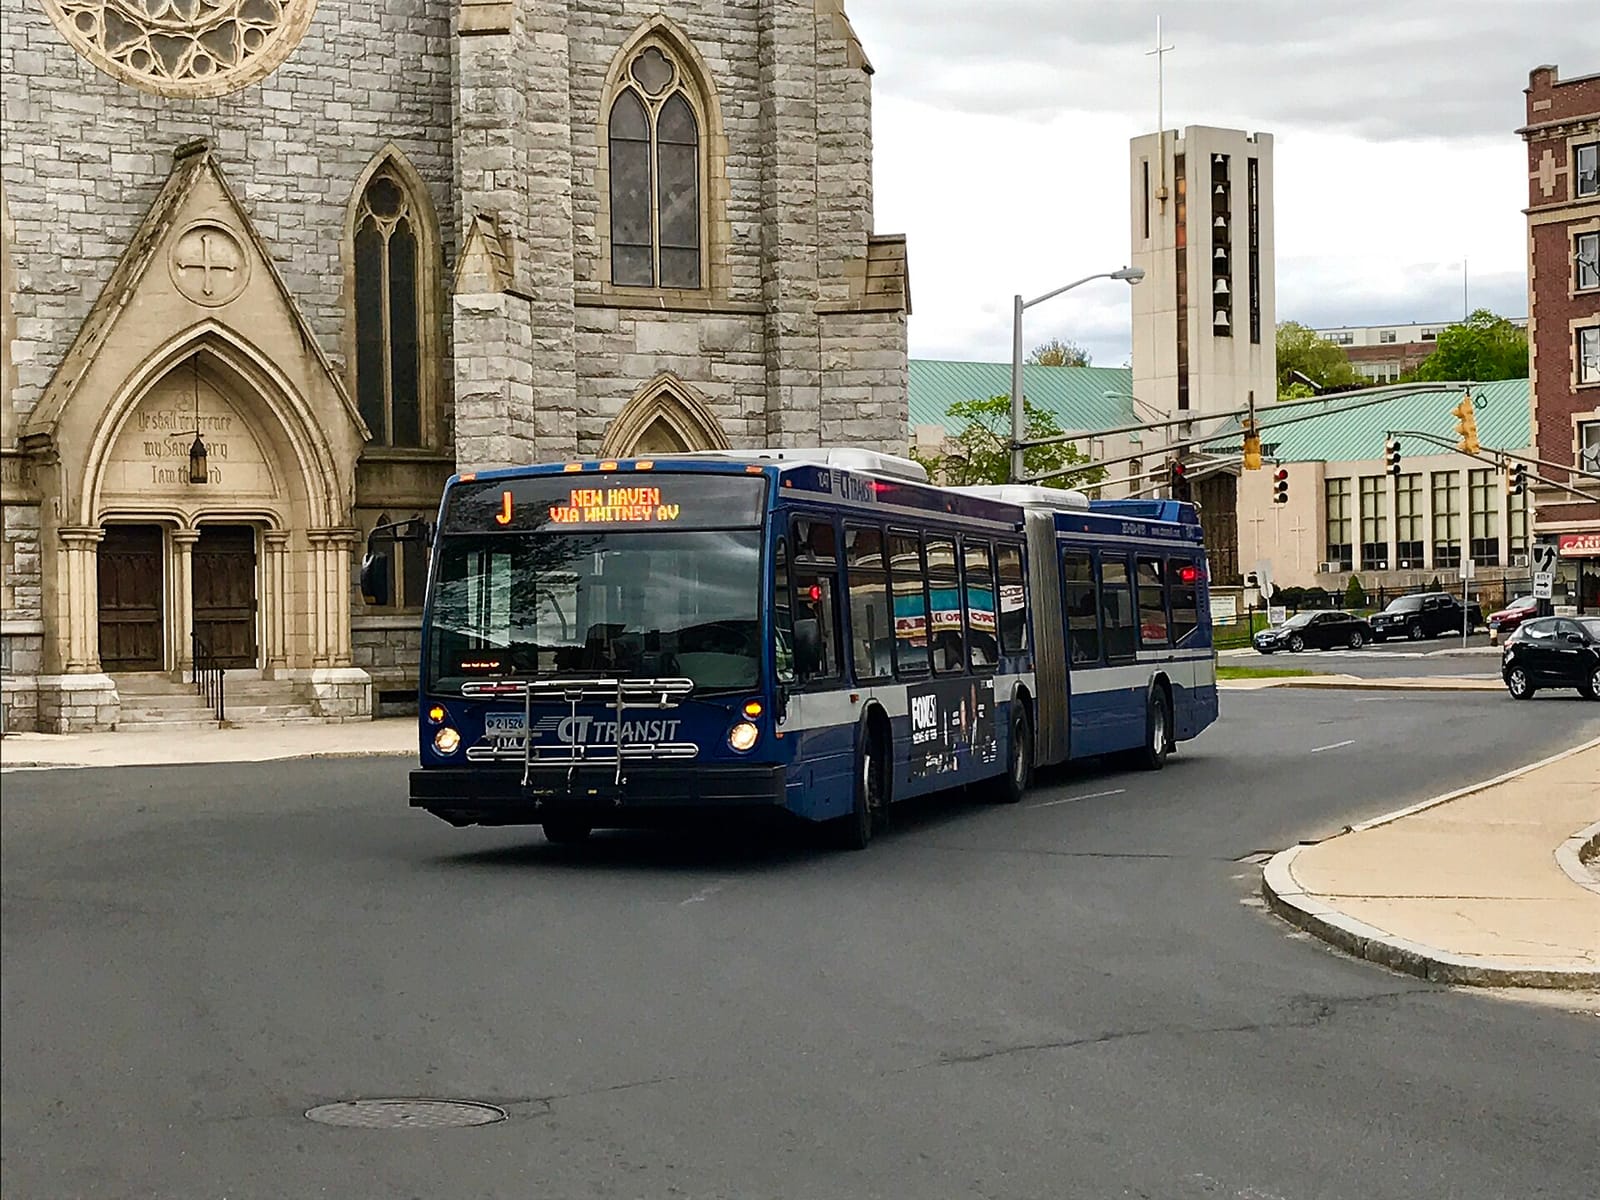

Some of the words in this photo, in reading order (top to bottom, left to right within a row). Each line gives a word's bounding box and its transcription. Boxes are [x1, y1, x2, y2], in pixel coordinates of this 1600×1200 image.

[152, 410, 176, 430] shall
[143, 441, 161, 459] my
[570, 489, 603, 507] NEW
[607, 487, 660, 506] HAVEN
[495, 491, 512, 525] J
[549, 506, 579, 523] VIA
[584, 505, 652, 522] WHITNEY
[656, 504, 680, 520] AV
